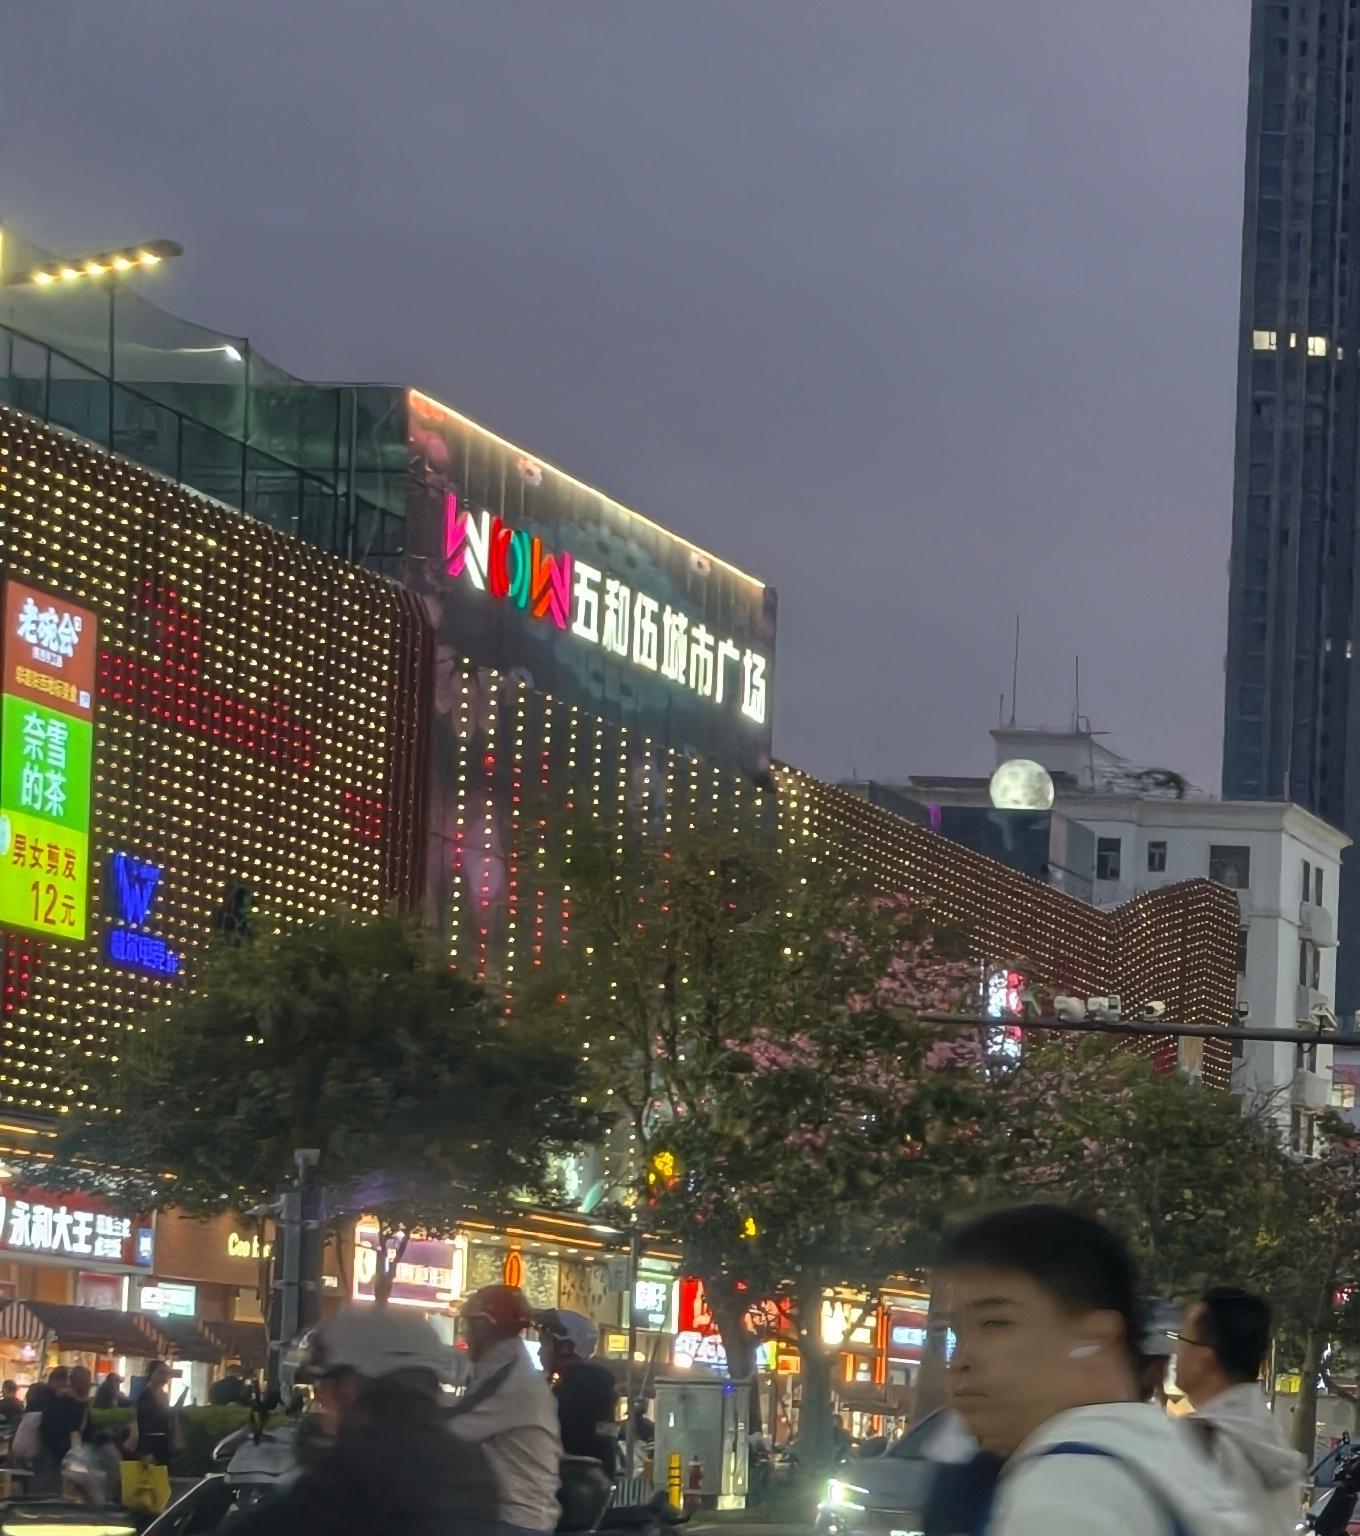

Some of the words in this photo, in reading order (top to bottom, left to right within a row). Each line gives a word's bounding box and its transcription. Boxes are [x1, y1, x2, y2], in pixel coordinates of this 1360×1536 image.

[443, 492, 572, 630] WOW
[571, 559, 767, 724] 五和伍城市广场
[22, 709, 69, 769] 奈雪
[20, 764, 68, 817] 的茶
[12, 833, 77, 882] 男女剪发
[30, 880, 76, 928] 12元
[8, 1200, 95, 1255] 永和大王
